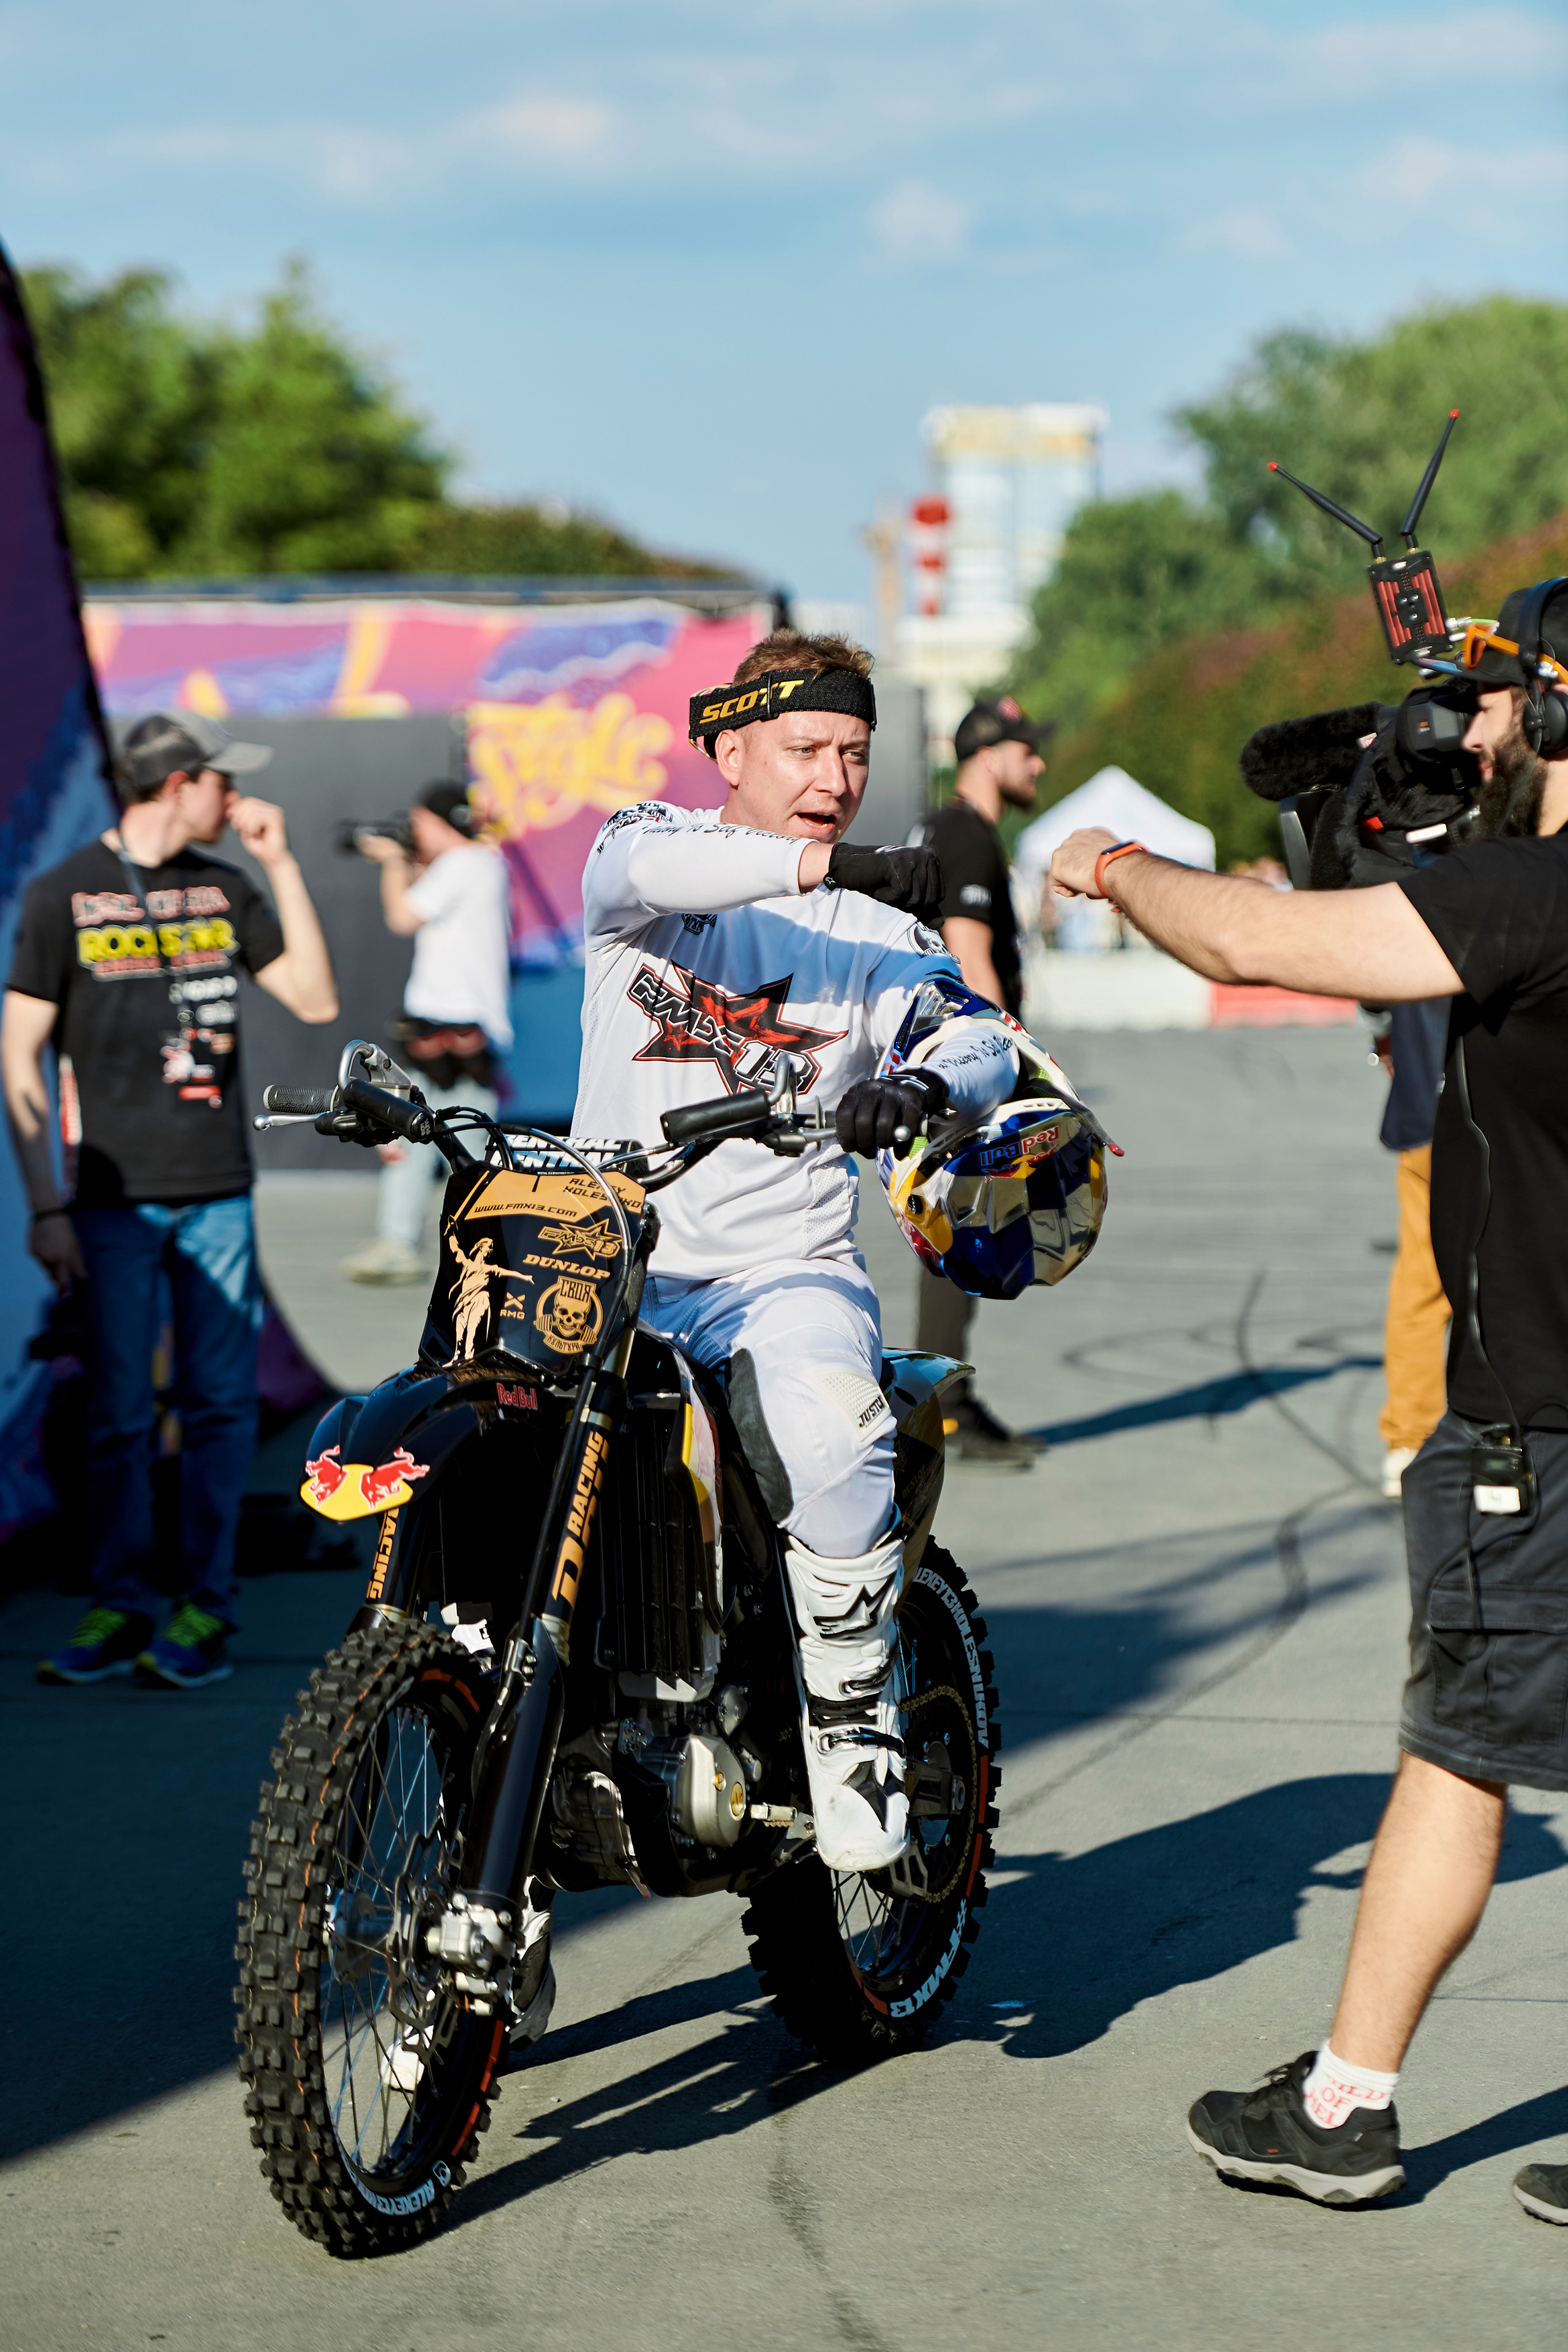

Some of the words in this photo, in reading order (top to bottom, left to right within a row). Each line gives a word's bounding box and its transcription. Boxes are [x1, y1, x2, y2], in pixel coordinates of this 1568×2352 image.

[699, 679, 805, 724] SCOTT
[1021, 1126, 1060, 1155] Red
[981, 1142, 1021, 1167] Bull
[522, 1253, 611, 1280] DUNLOP
[560, 1278, 592, 1303] СВОЯ
[500, 1309, 526, 1321] RMG
[547, 1334, 581, 1352] КУЛЬТУРА
[497, 1382, 518, 1406] Red
[518, 1385, 538, 1411] Bull
[566, 1430, 603, 1538] RACING
